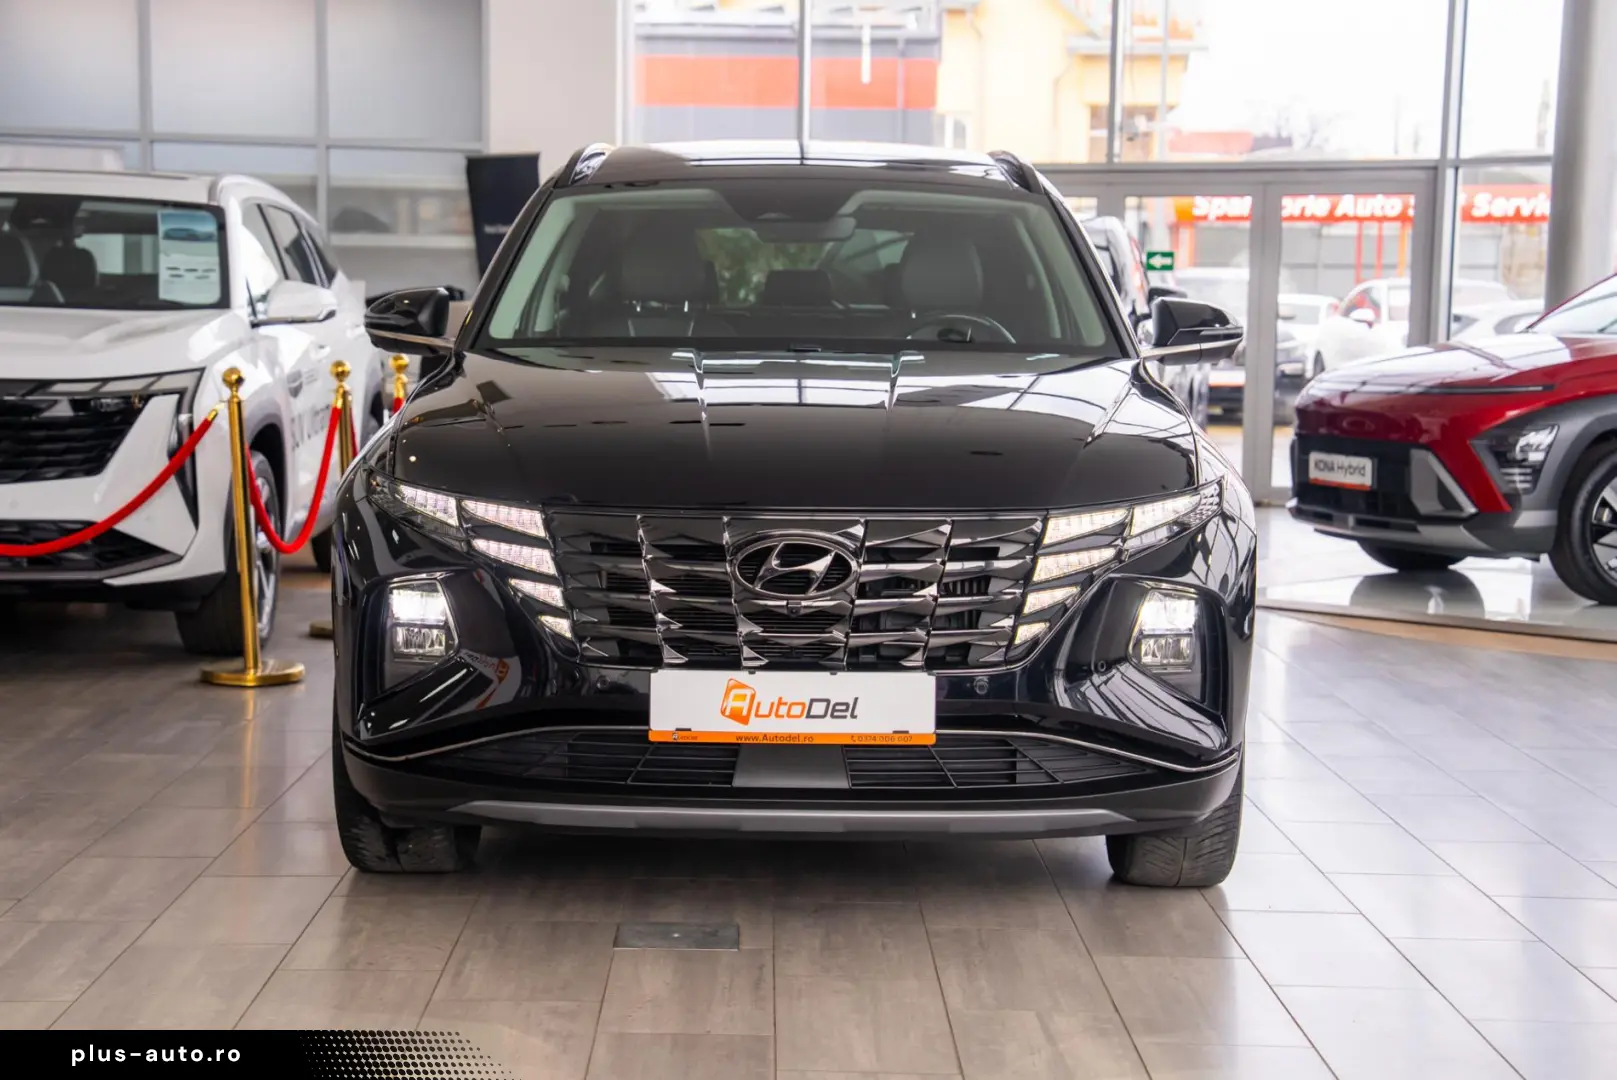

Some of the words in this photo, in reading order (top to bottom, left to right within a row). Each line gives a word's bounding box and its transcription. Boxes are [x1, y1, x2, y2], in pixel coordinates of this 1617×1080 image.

[1335, 193, 1403, 217] Auto
[1313, 459, 1335, 472] KONA
[1336, 460, 1367, 477] Hybrid
[721, 685, 859, 721] AutoDel
[735, 733, 814, 743] www.Autodel.ro
